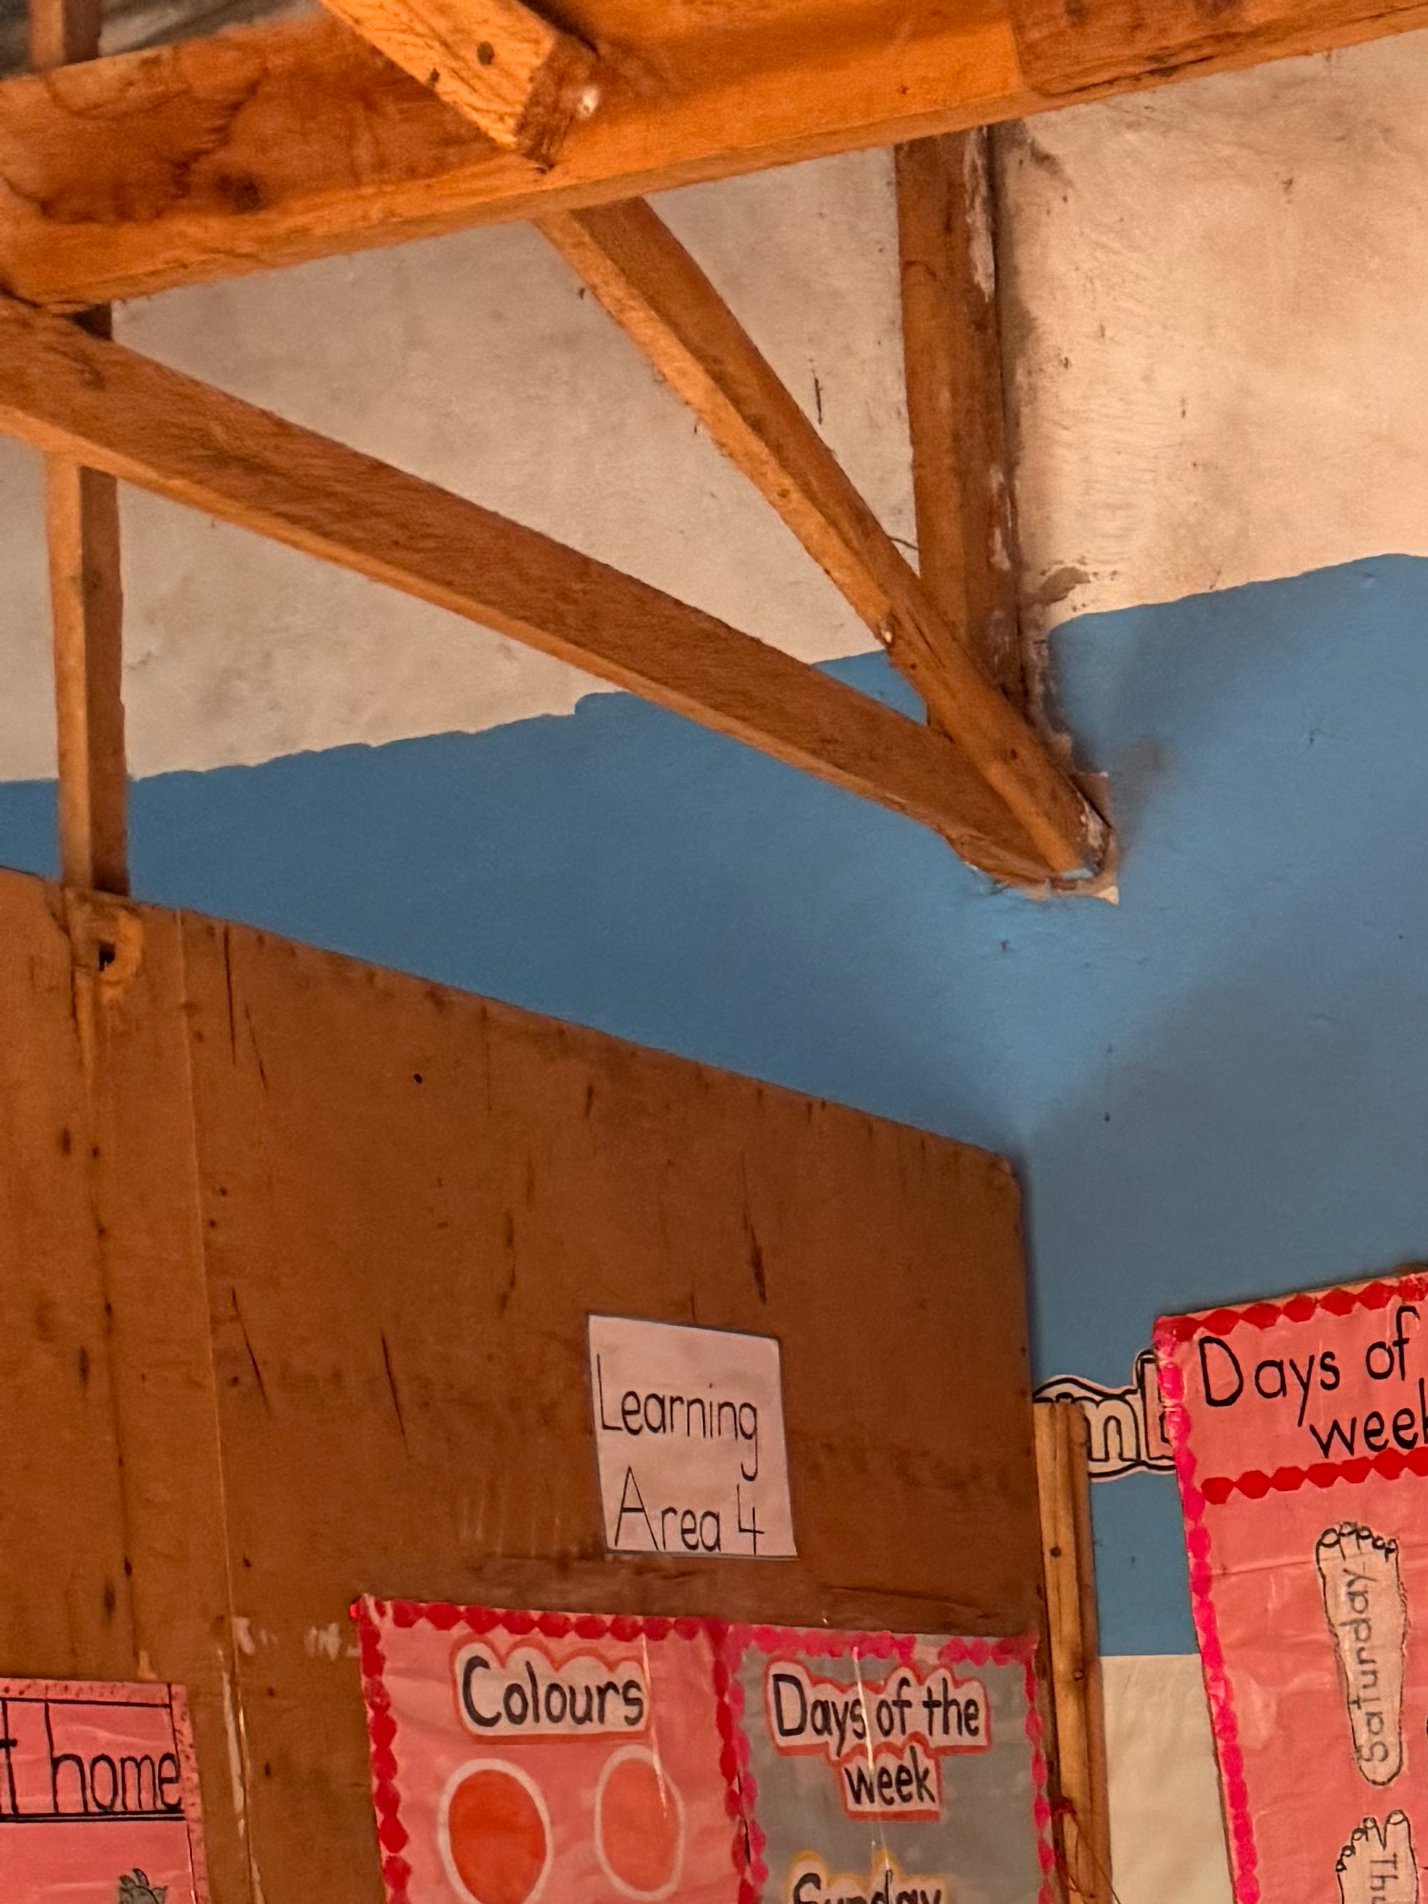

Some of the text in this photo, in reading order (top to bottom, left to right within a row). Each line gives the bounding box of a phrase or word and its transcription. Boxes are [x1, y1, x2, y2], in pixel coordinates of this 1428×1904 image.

[1200, 1335, 1341, 1426] Days
[1365, 1306, 1420, 1382] of
[597, 1353, 758, 1481] Learning
[614, 1465, 766, 1555] Area 4
[462, 1654, 644, 1727] Colours
[1339, 1567, 1389, 1762] Saturday
[45, 1702, 182, 1813] home
[772, 1673, 981, 1757] Days of the
[845, 1746, 935, 1806] week
